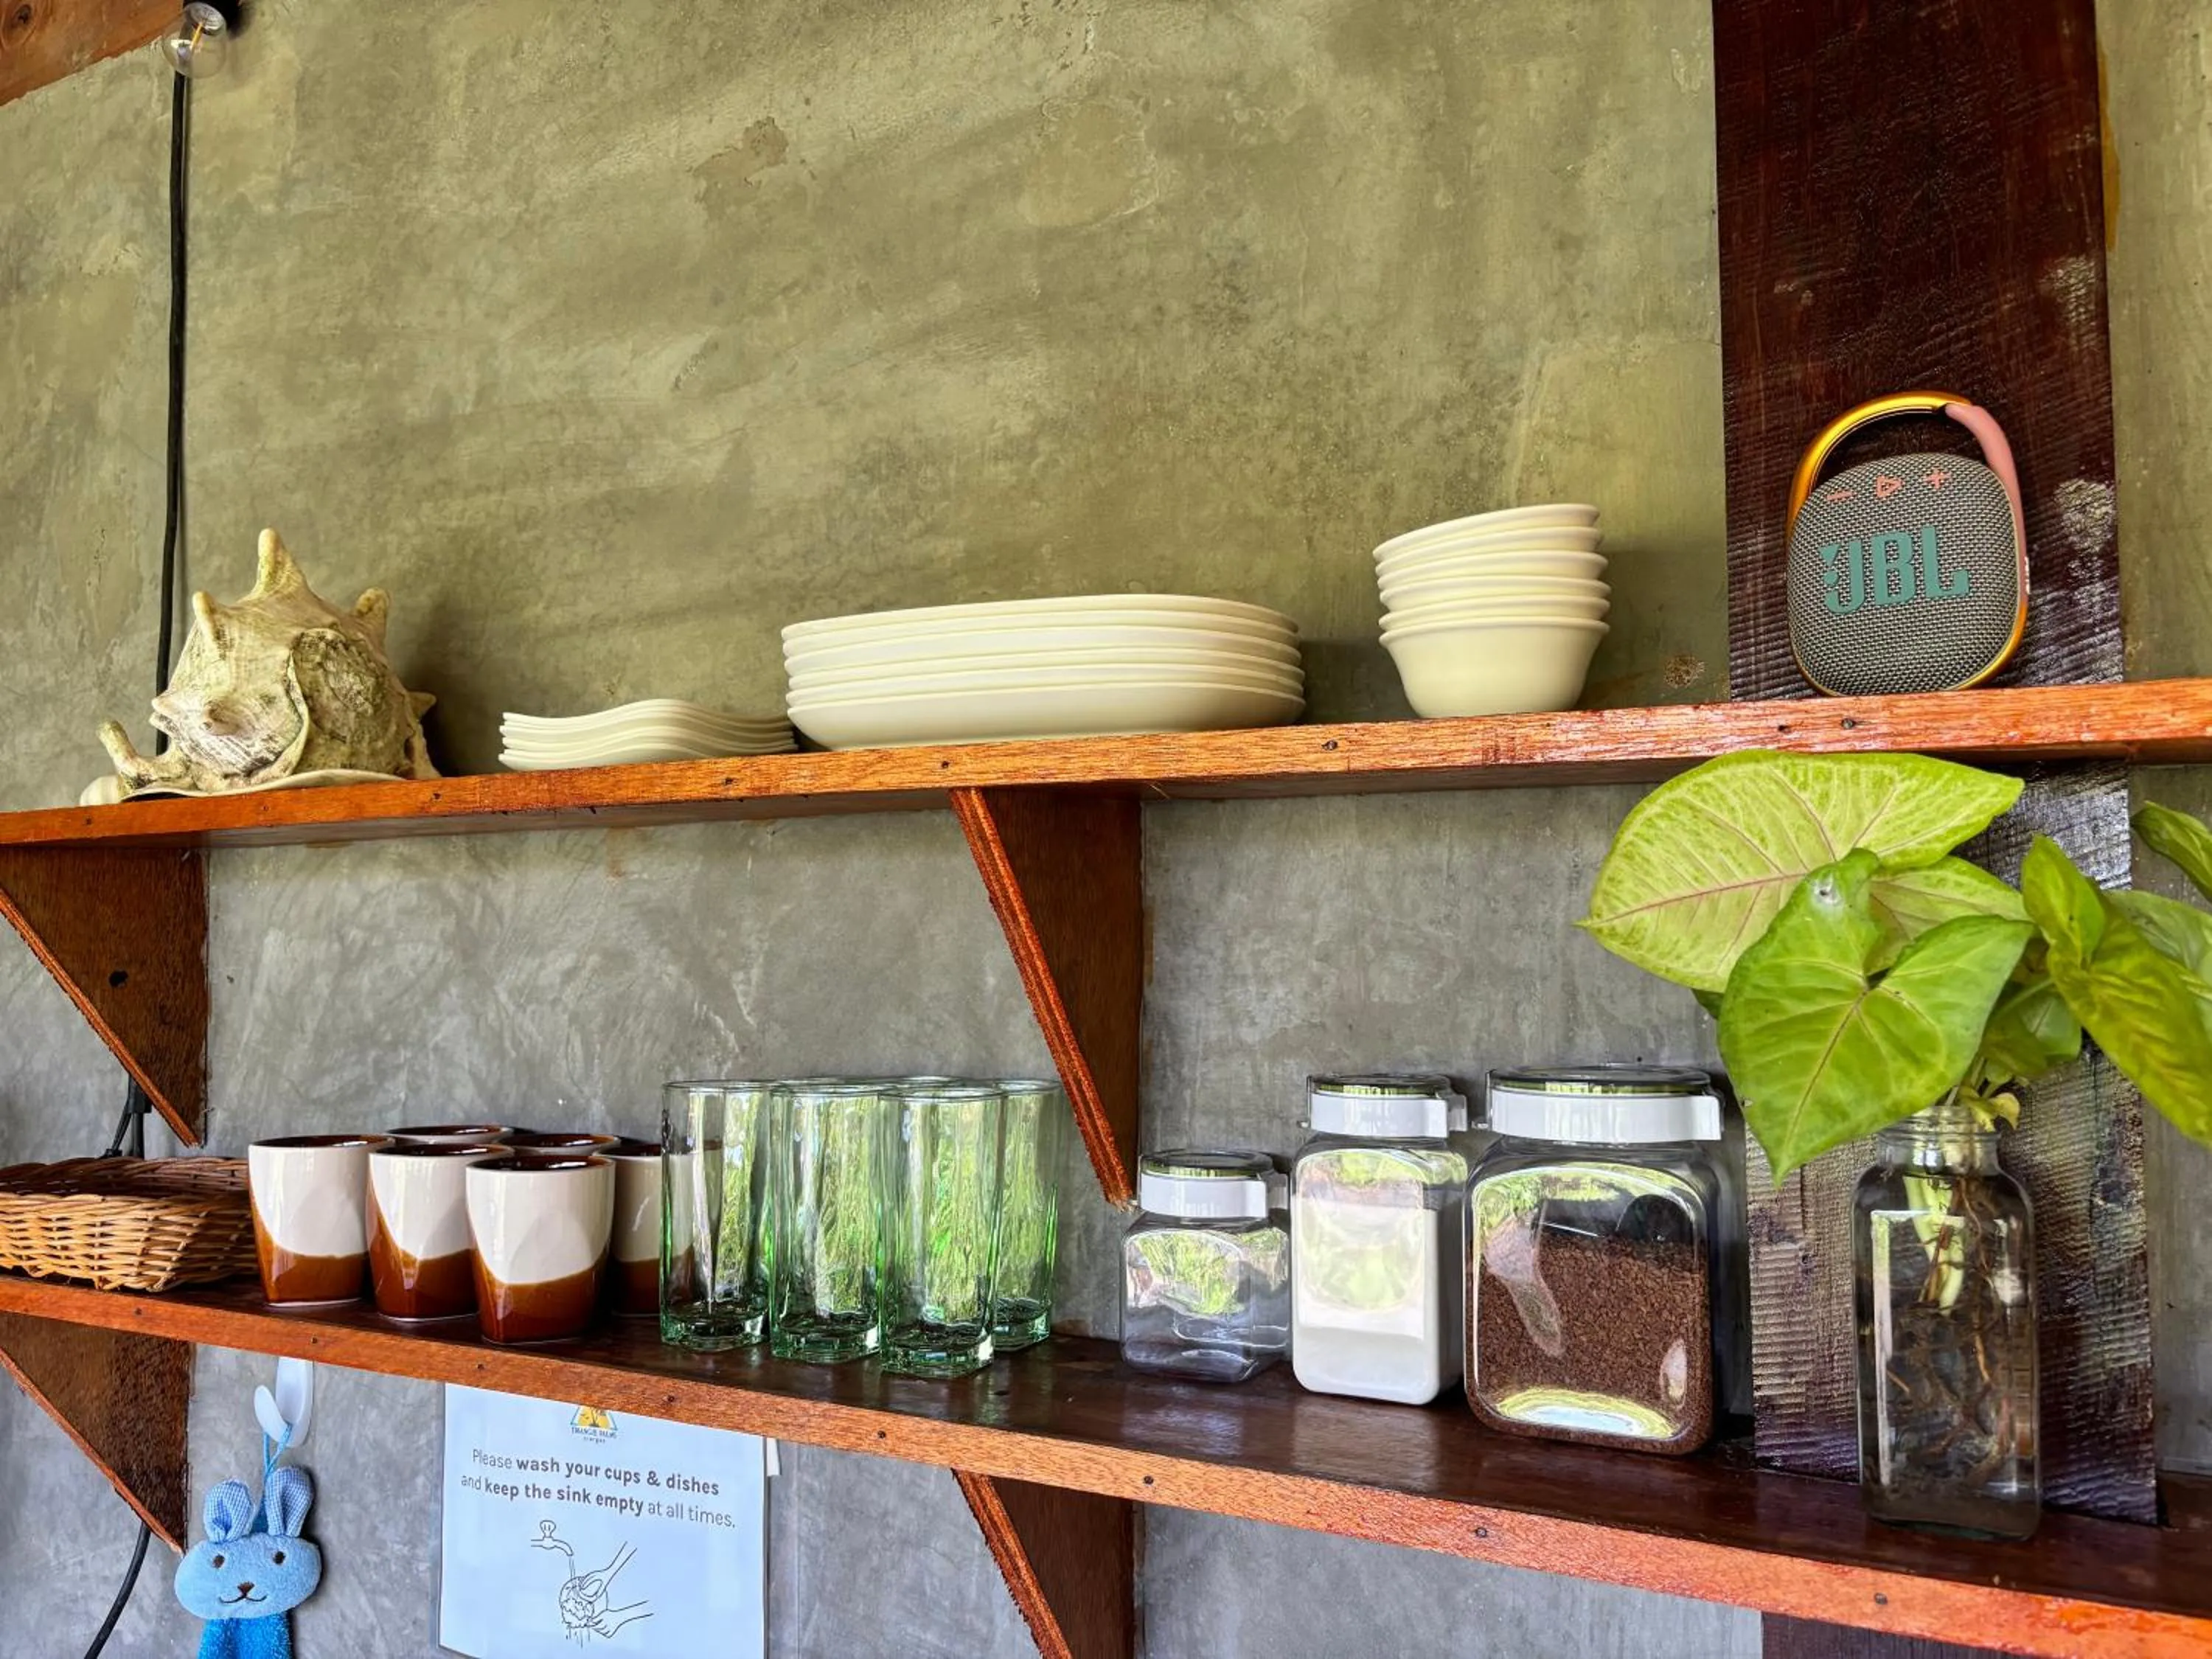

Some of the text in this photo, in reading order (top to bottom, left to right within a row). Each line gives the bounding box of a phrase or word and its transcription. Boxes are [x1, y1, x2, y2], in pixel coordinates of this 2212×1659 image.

[1818, 524, 1970, 615] JBL
[473, 1449, 720, 1495] Please wash your cups & dishes
[461, 1475, 736, 1528] and keep the sink empty at all times.
